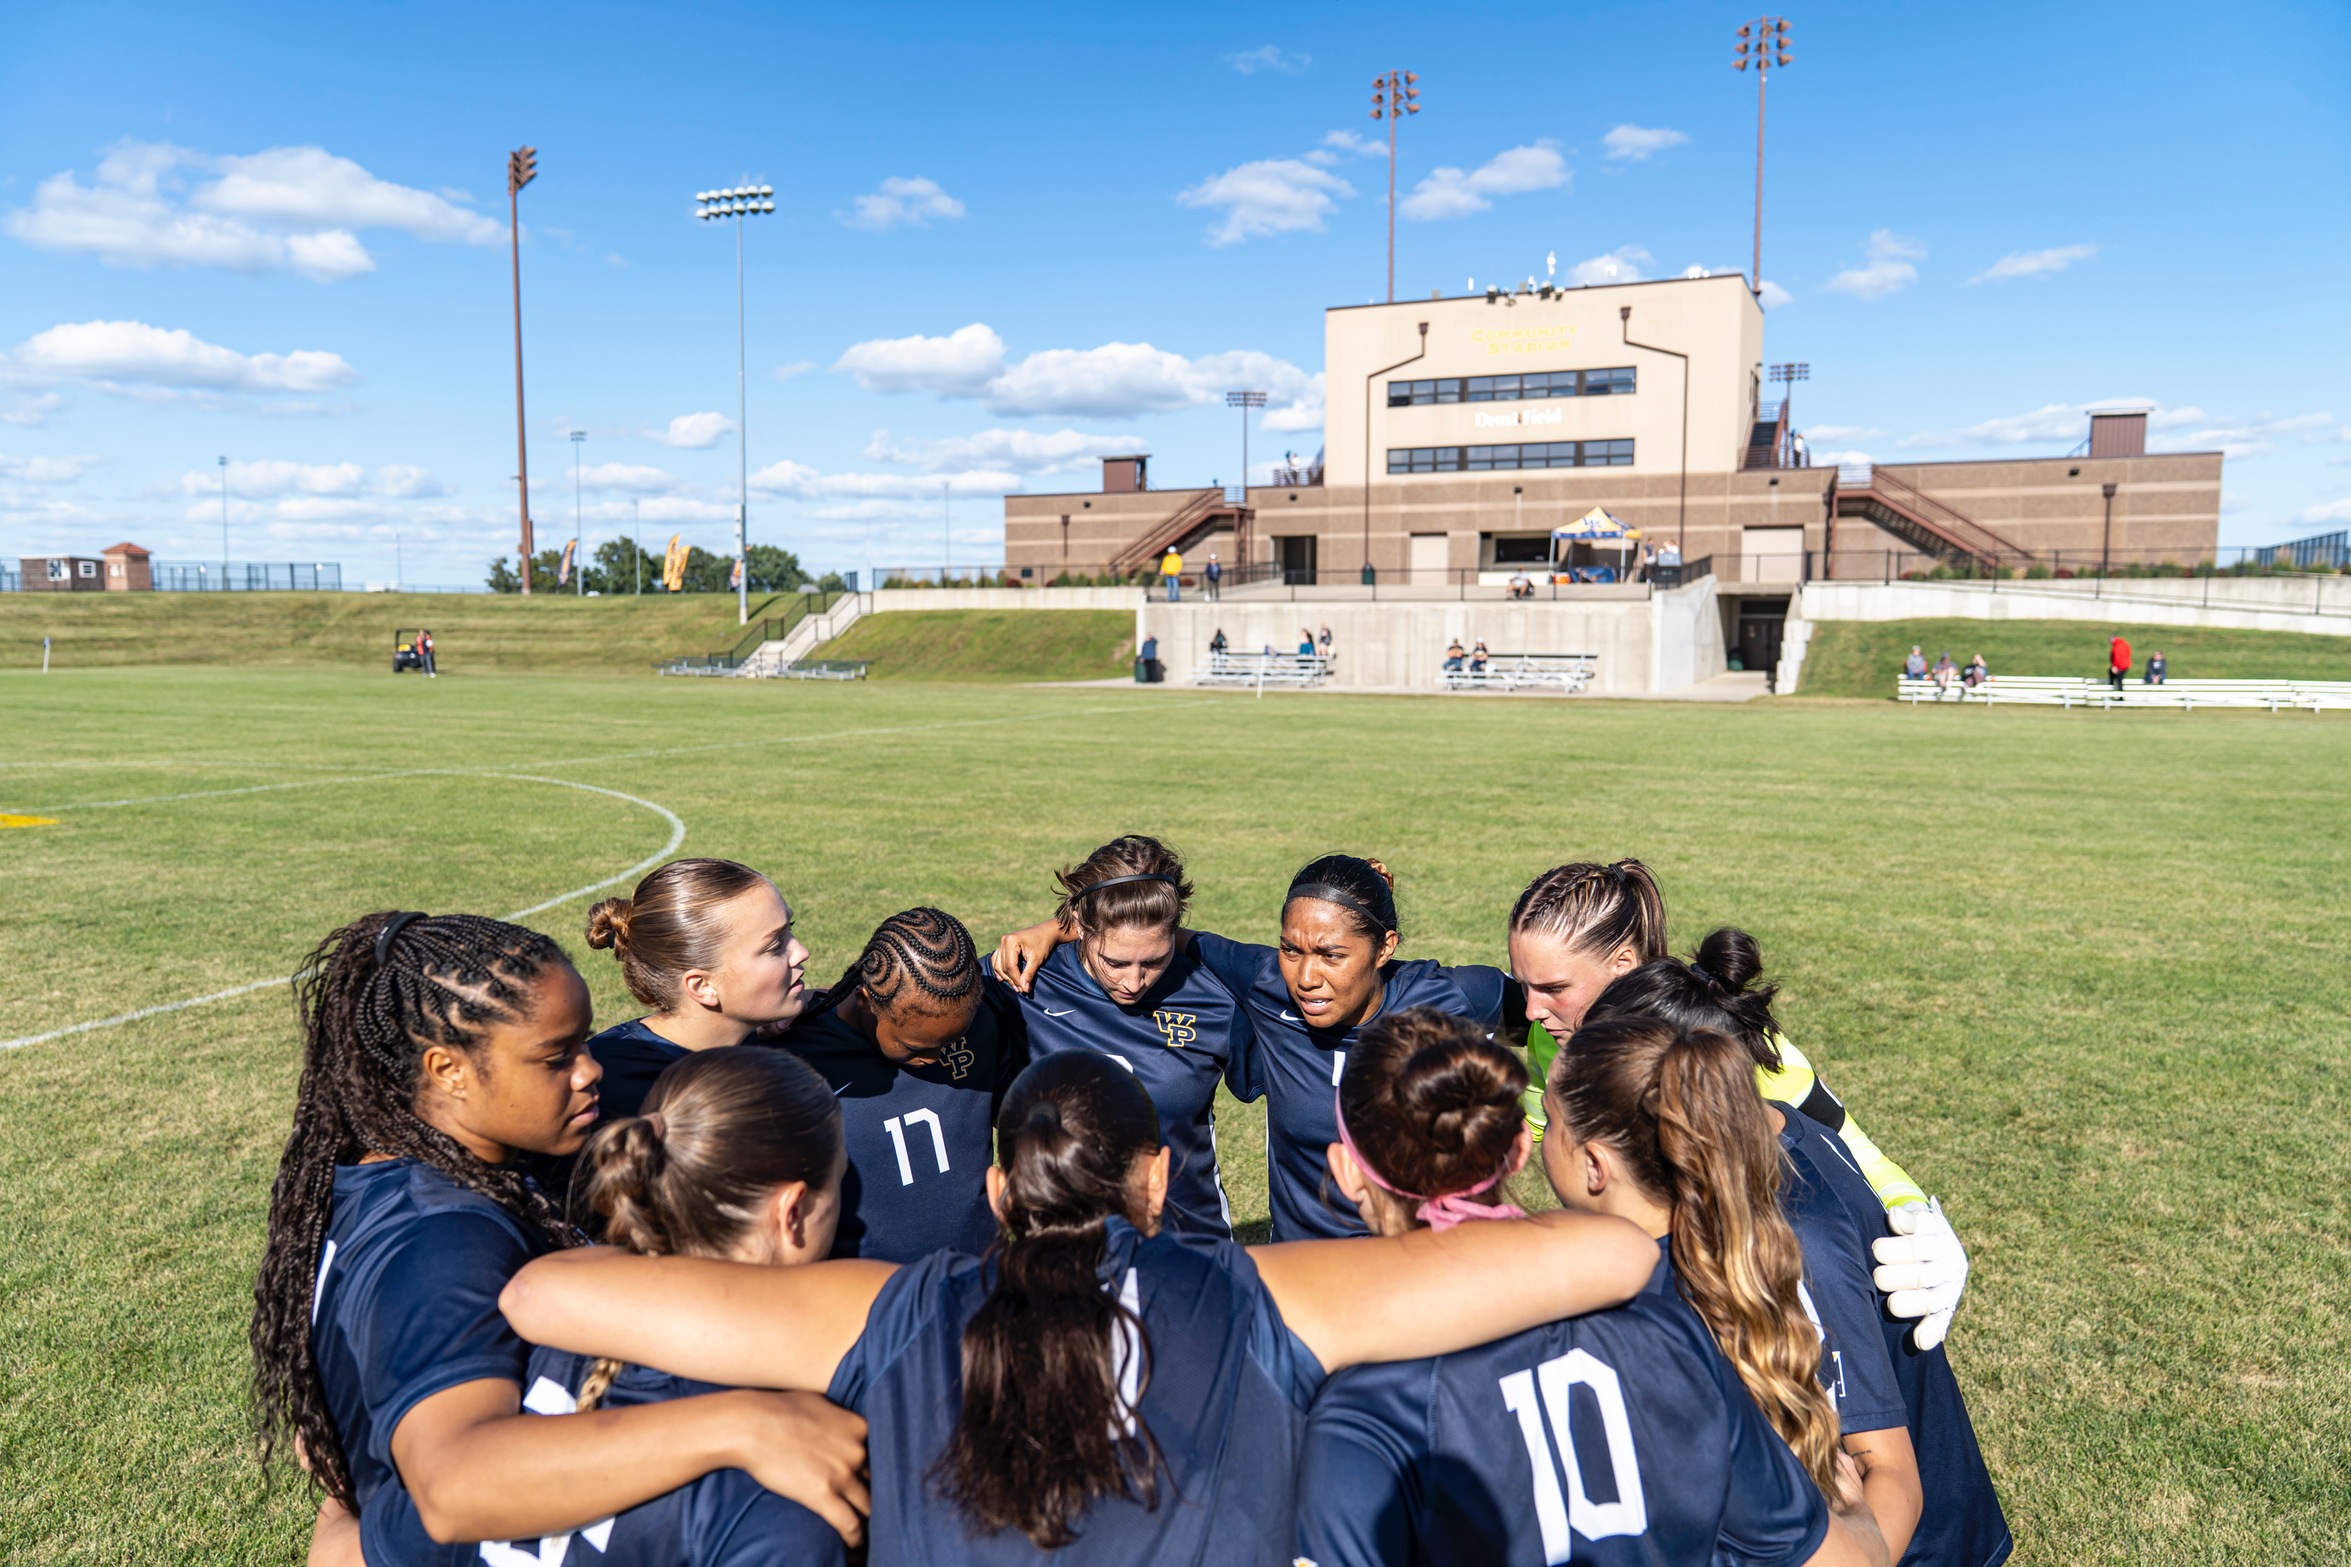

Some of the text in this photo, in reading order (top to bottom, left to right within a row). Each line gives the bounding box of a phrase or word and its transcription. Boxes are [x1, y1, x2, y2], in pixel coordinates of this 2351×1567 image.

[1471, 324, 1578, 342] COMMUNITY
[1487, 339, 1571, 354] STADIUM
[1523, 407, 1562, 427] Field
[883, 1107, 950, 1187] 17
[1499, 1347, 1648, 1566] 10
